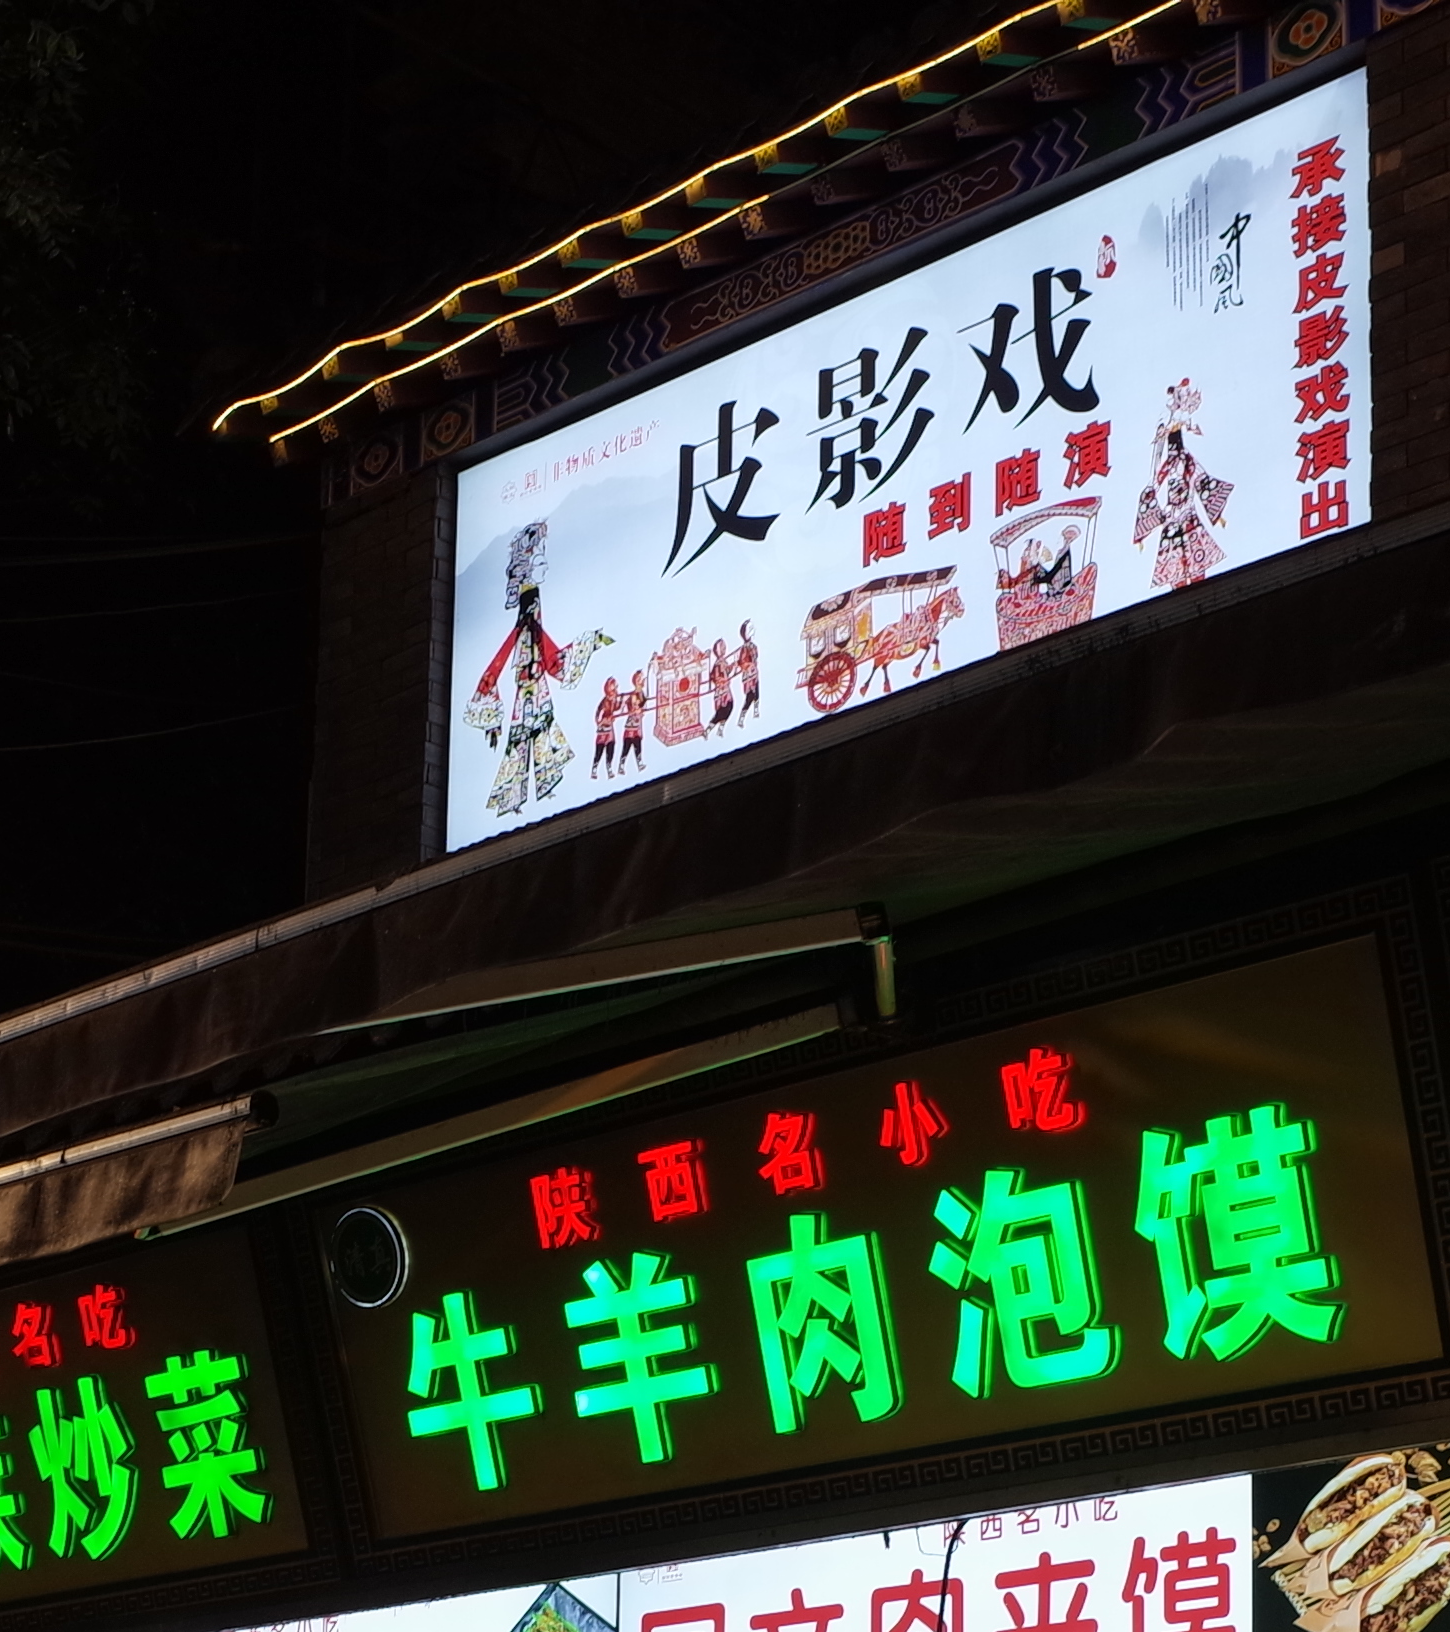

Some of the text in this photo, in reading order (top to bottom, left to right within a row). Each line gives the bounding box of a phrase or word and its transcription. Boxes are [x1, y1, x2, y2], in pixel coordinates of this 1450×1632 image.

[660, 265, 1103, 579] 皮影戏
[1291, 136, 1350, 540] 承接皮影戏演出
[862, 419, 1113, 569] 随到随演
[530, 1047, 1087, 1251] 陕西名小吃
[406, 1102, 1348, 1494] 牛羊肉泡馍
[942, 1496, 1119, 1547] 陕西名小吃
